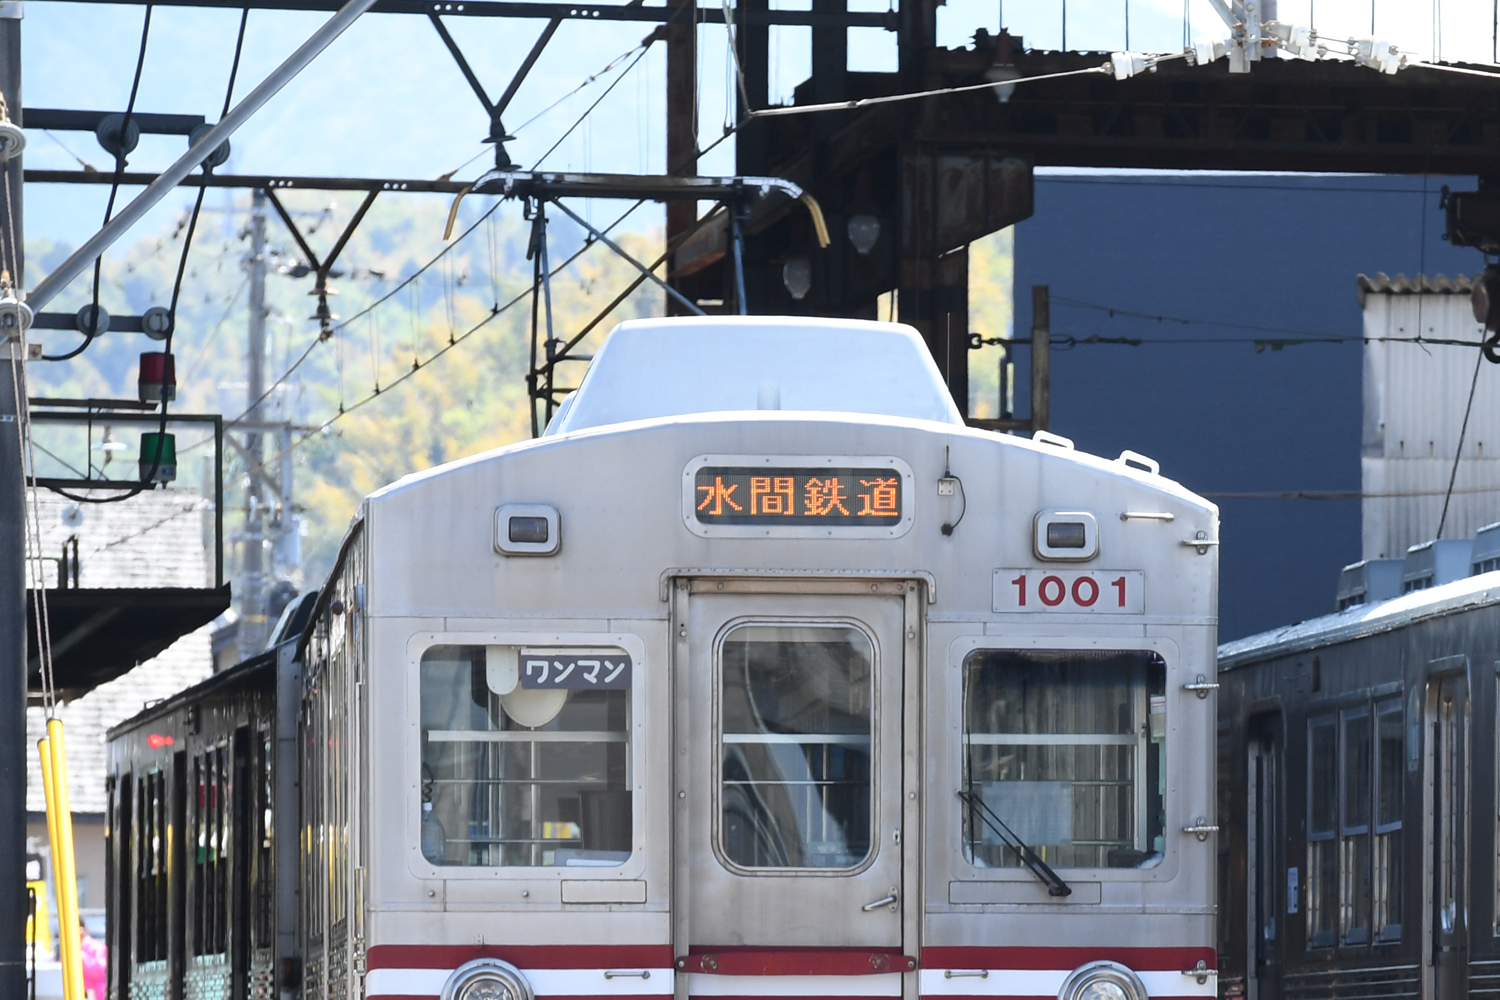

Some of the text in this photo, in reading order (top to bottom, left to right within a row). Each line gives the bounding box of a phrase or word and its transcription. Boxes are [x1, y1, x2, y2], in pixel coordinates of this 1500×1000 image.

[697, 476, 899, 516] 水間鉄道
[1011, 574, 1126, 607] 1001
[525, 660, 626, 684] ワンマン
